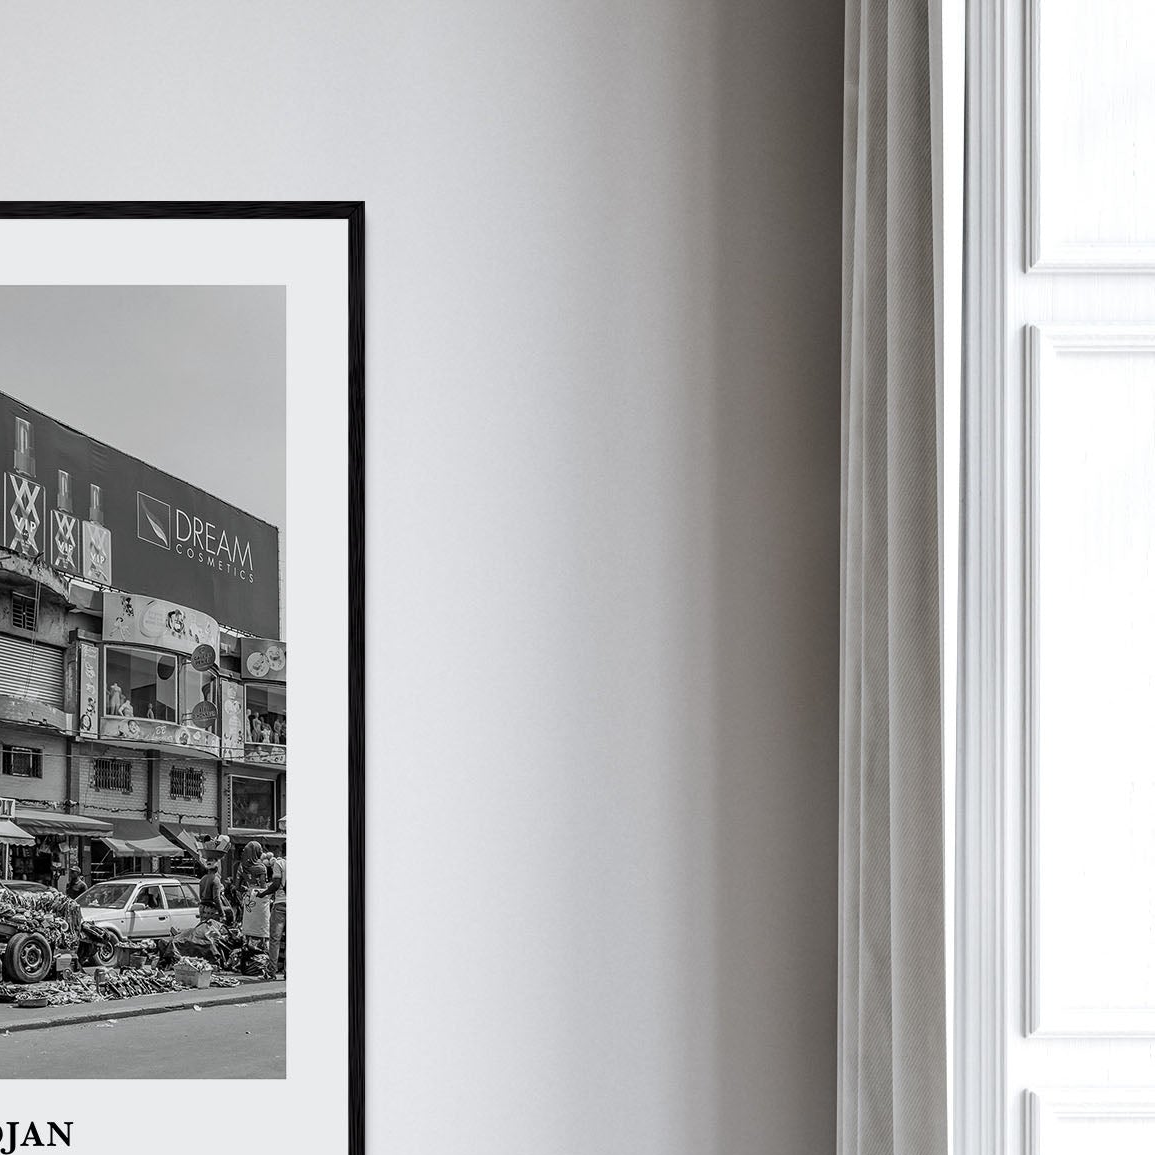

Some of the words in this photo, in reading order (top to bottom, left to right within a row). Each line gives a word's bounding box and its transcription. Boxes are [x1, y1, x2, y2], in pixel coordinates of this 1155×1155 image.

[13, 514, 37, 533] VIP
[57, 540, 74, 553] VIP
[176, 509, 253, 571] DREAM
[175, 543, 254, 584] COSMETICS
